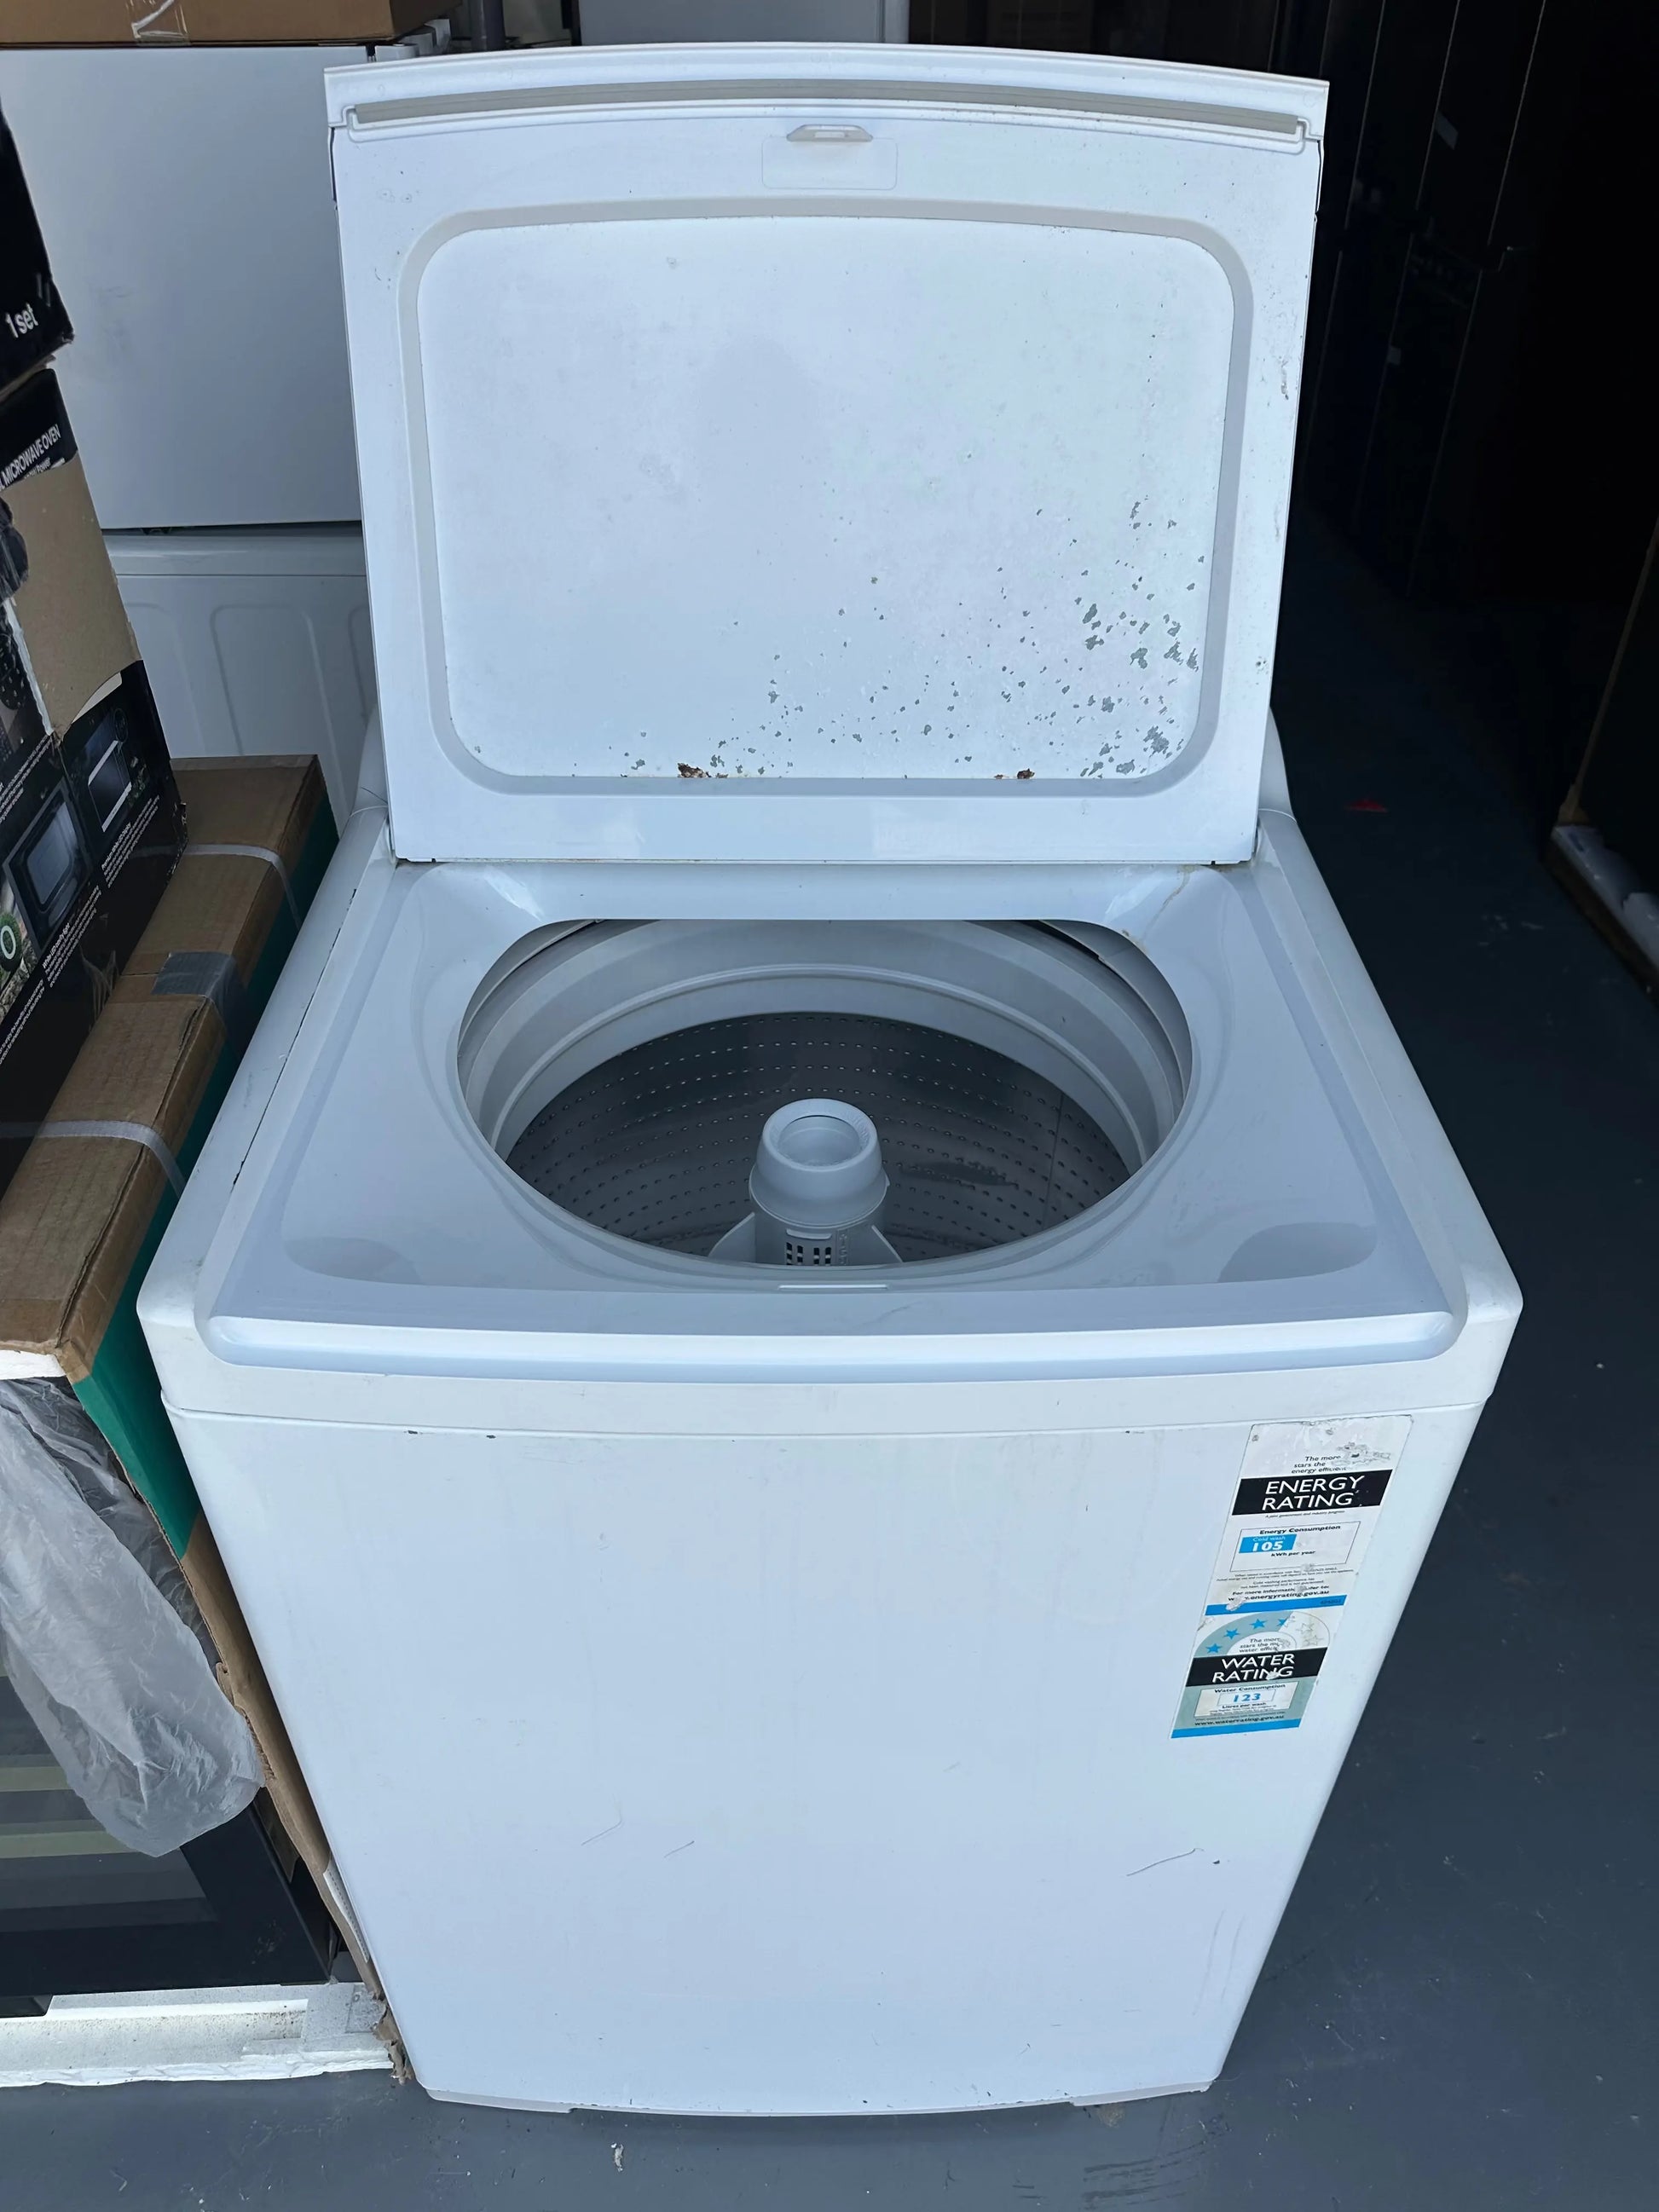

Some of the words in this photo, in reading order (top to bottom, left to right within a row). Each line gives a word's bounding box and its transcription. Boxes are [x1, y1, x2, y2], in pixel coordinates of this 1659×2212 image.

[1, 438, 44, 487] MICROWAVE
[41, 424, 61, 450] OVEN
[1265, 1476, 1365, 1495] ENERGY
[1262, 1493, 1355, 1511] RATING
[1252, 1541, 1284, 1552] 105
[1222, 1654, 1295, 1669] WATER
[1212, 1666, 1294, 1684] RATING
[1233, 1693, 1261, 1702] 123
